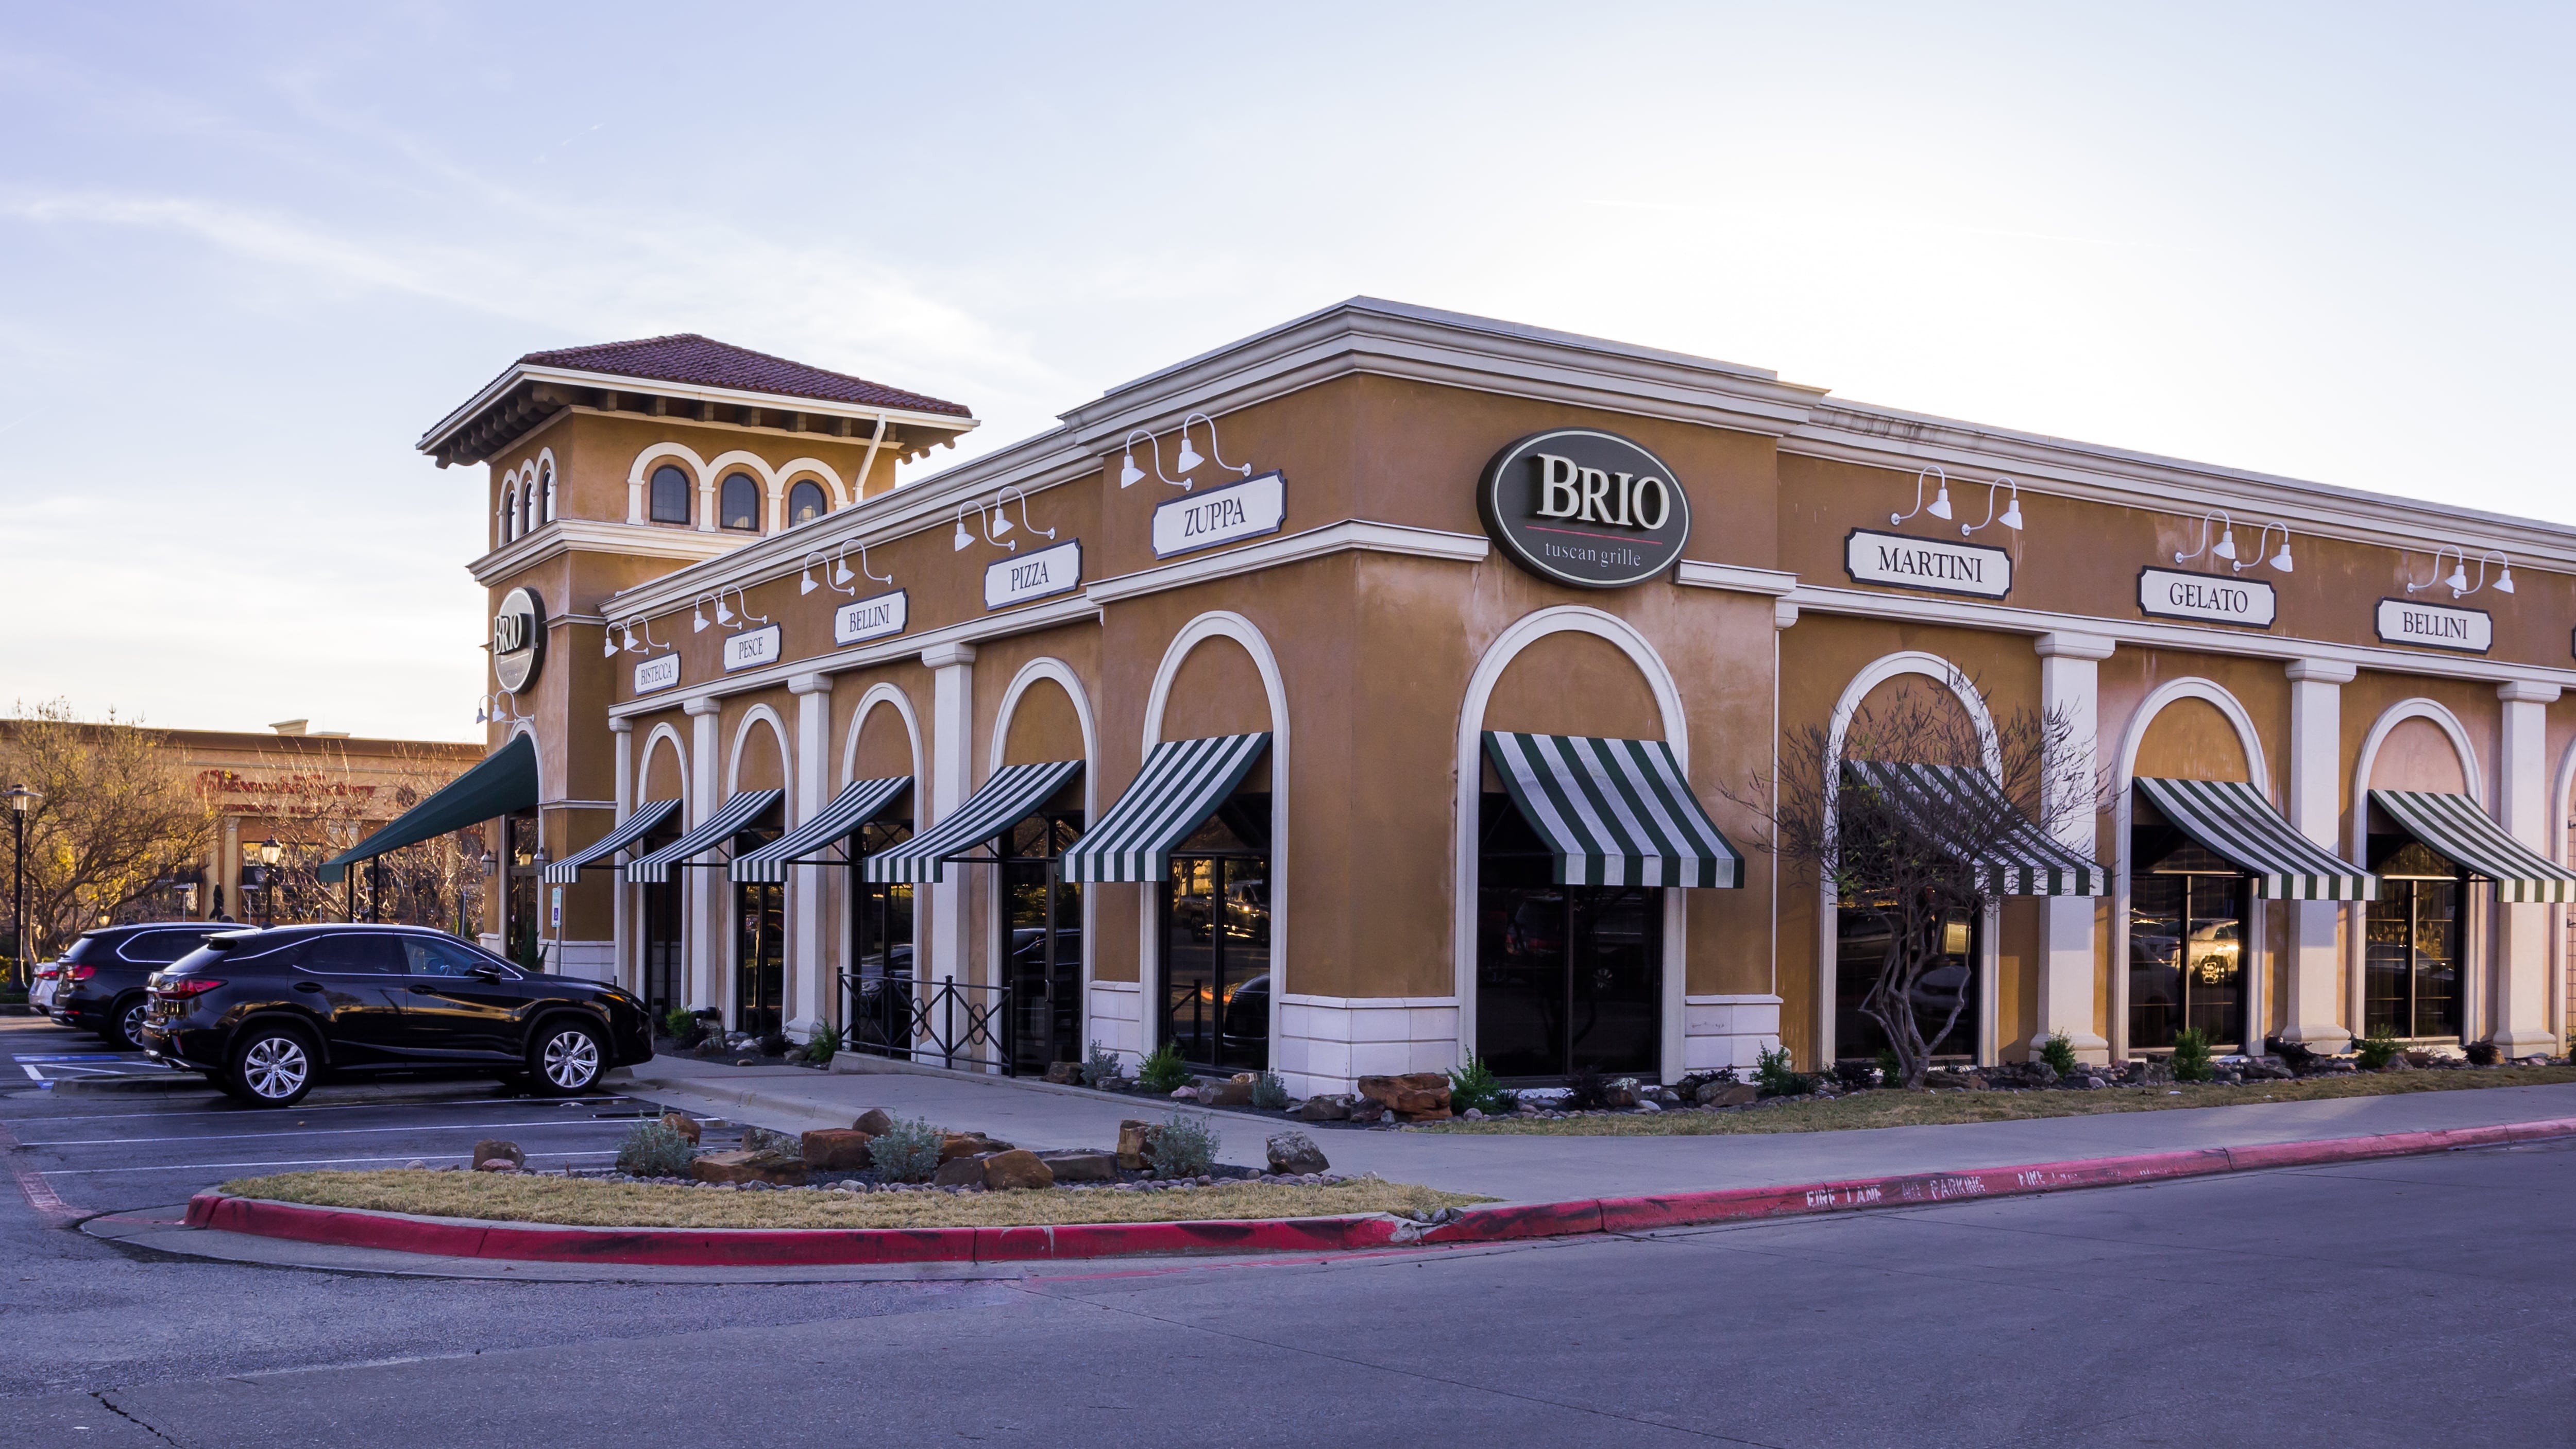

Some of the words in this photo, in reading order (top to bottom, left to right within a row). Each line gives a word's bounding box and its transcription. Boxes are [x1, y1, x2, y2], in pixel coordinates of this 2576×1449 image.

[1537, 453, 1670, 530] BRIO
[1184, 497, 1246, 537] ZUPPA
[1546, 542, 1596, 561] tuscan
[1601, 549, 1641, 567] grille
[1878, 545, 1982, 583] MARTINI
[1011, 560, 1049, 591] PIZZA
[2170, 583, 2248, 613] GELATO
[849, 603, 890, 633] BELLINI
[2402, 611, 2468, 640] BELLINI
[494, 613, 522, 655] BRIO
[739, 637, 763, 659] PESCE
[641, 663, 672, 686] BISTECCA
[1930, 1177, 1986, 1200] PARKING
